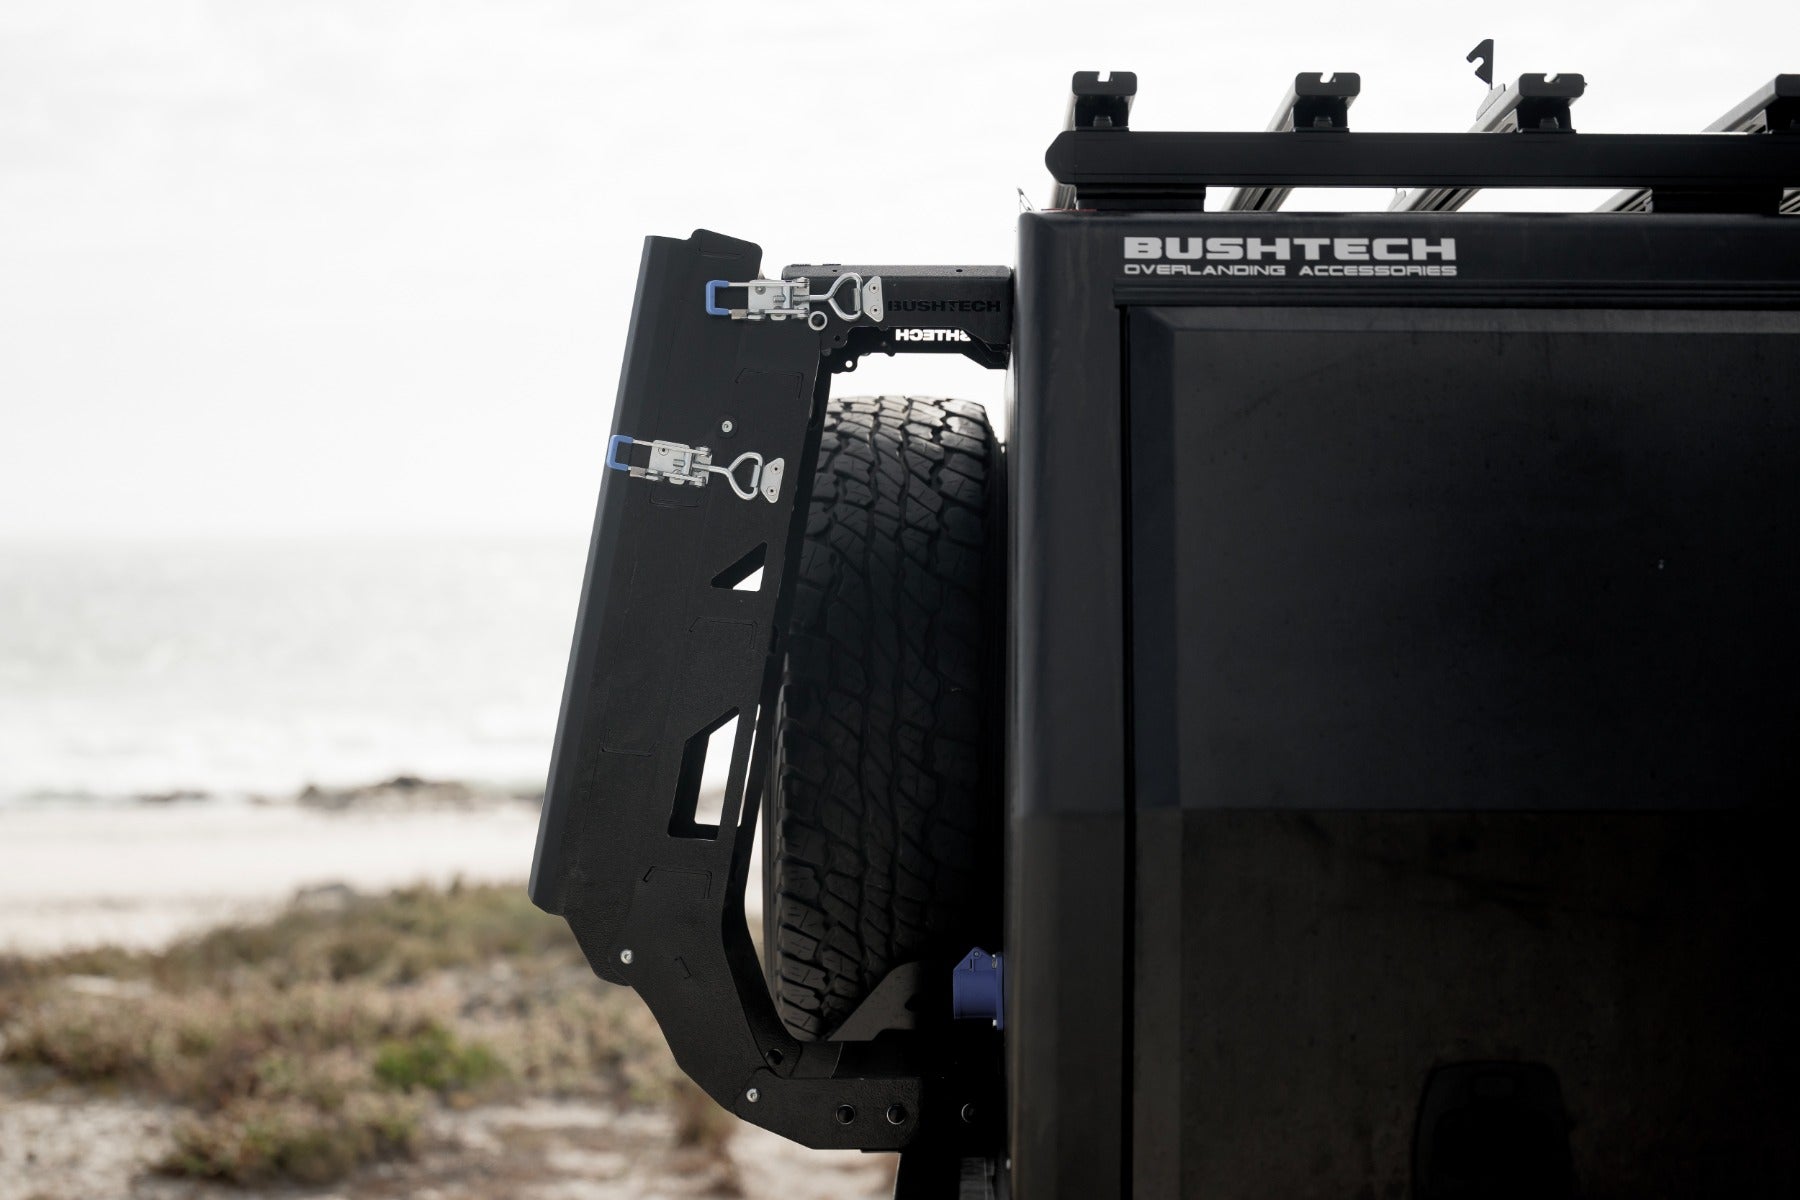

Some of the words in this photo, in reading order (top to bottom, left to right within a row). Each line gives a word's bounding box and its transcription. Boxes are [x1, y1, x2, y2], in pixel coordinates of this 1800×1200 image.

[1124, 237, 1457, 260] BUSHTECH
[1124, 264, 1286, 276] OVERLANDING
[1299, 265, 1457, 276] ACCESSORIES
[887, 300, 1001, 312] BUSHTECH
